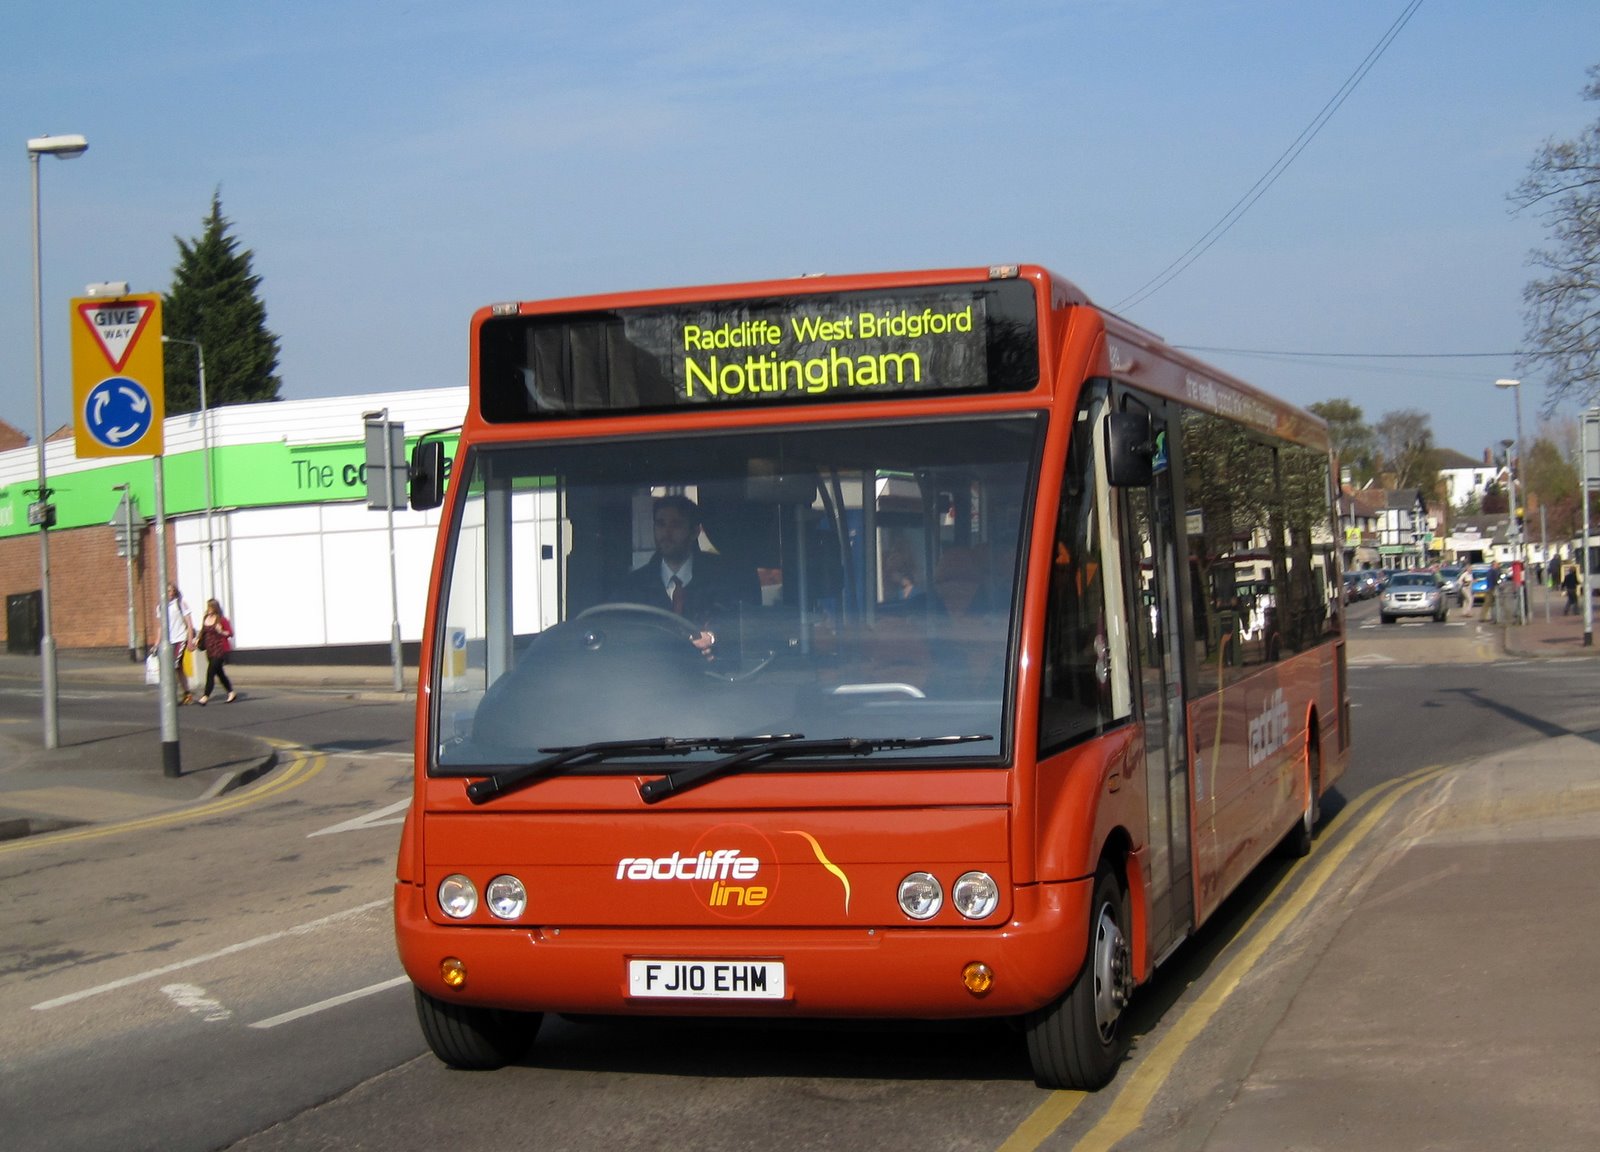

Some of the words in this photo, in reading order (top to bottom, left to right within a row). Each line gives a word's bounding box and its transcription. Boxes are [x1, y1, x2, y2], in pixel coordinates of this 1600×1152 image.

[94, 310, 137, 326] GIVE
[684, 320, 781, 351] Radcliffe
[791, 315, 853, 343] West
[859, 305, 971, 338] Bridgford
[103, 328, 131, 339] WAY
[685, 347, 920, 397] Nottingham
[292, 459, 333, 489] The
[616, 850, 760, 880] radcliffe
[709, 880, 768, 906] line
[646, 965, 705, 991] FJ10
[714, 966, 767, 992] EHM
